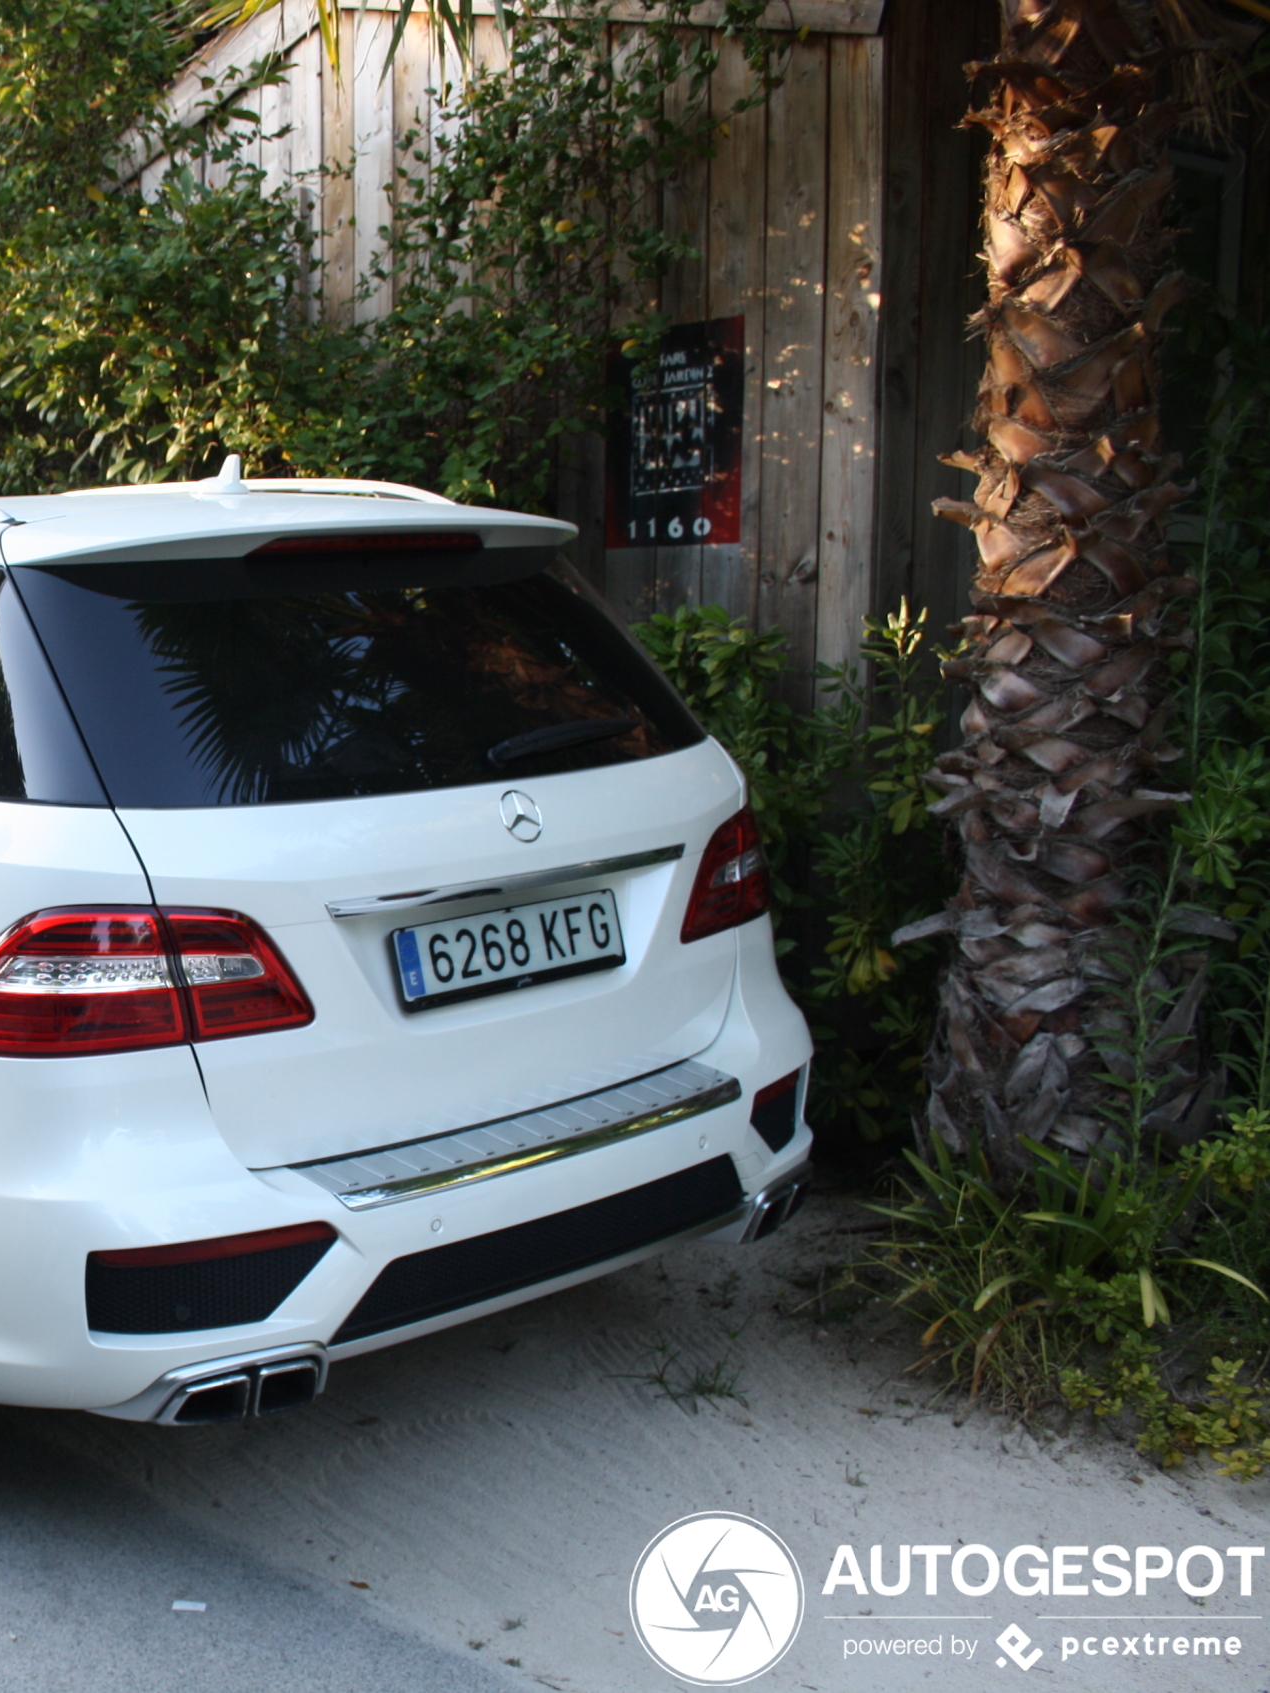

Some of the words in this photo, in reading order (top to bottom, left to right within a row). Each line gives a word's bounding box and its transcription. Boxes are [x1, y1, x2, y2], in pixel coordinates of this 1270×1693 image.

[629, 517, 711, 538] 1160
[428, 919, 530, 983] 6268
[539, 903, 610, 961] KFG
[410, 971, 418, 986] E
